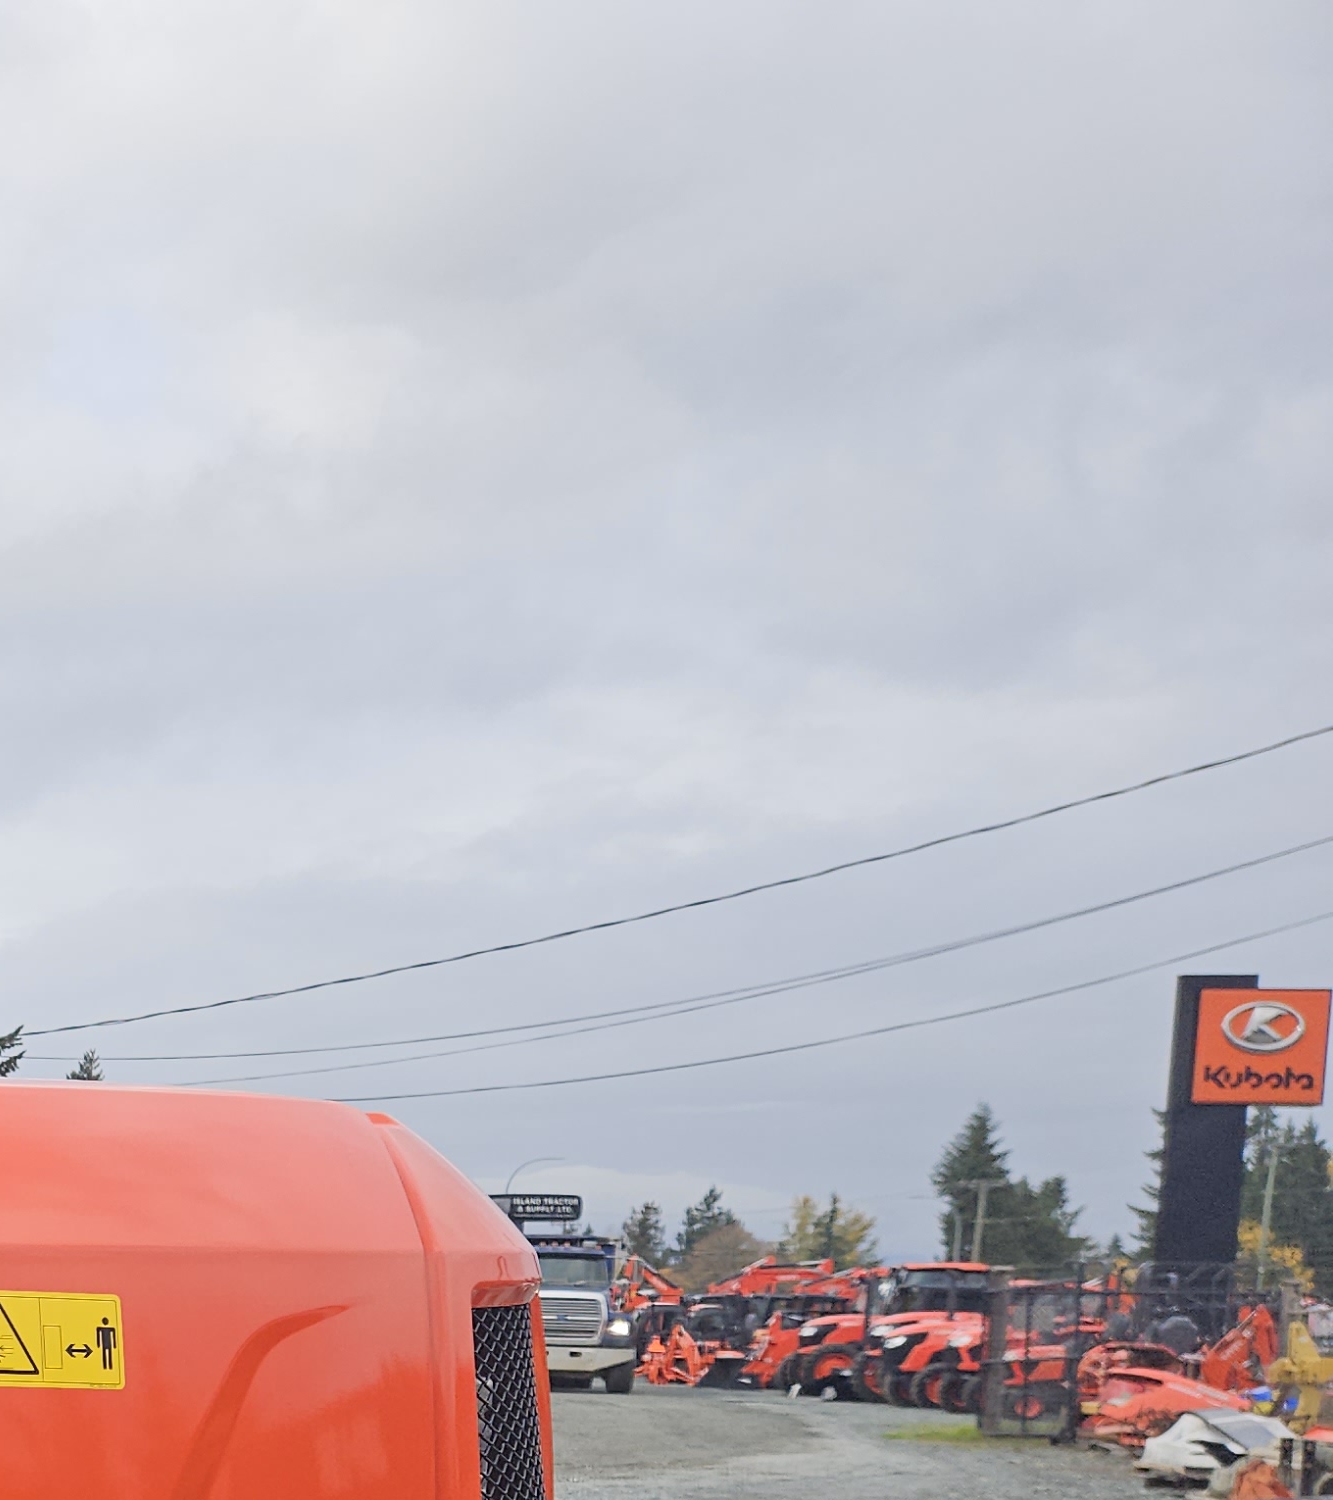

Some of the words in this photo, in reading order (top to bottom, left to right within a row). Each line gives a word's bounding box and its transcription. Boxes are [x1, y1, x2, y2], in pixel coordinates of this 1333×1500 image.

[1203, 1065, 1315, 1091] Kubota
[513, 1197, 542, 1205] ISLAND
[543, 1197, 579, 1206] TRACTOR
